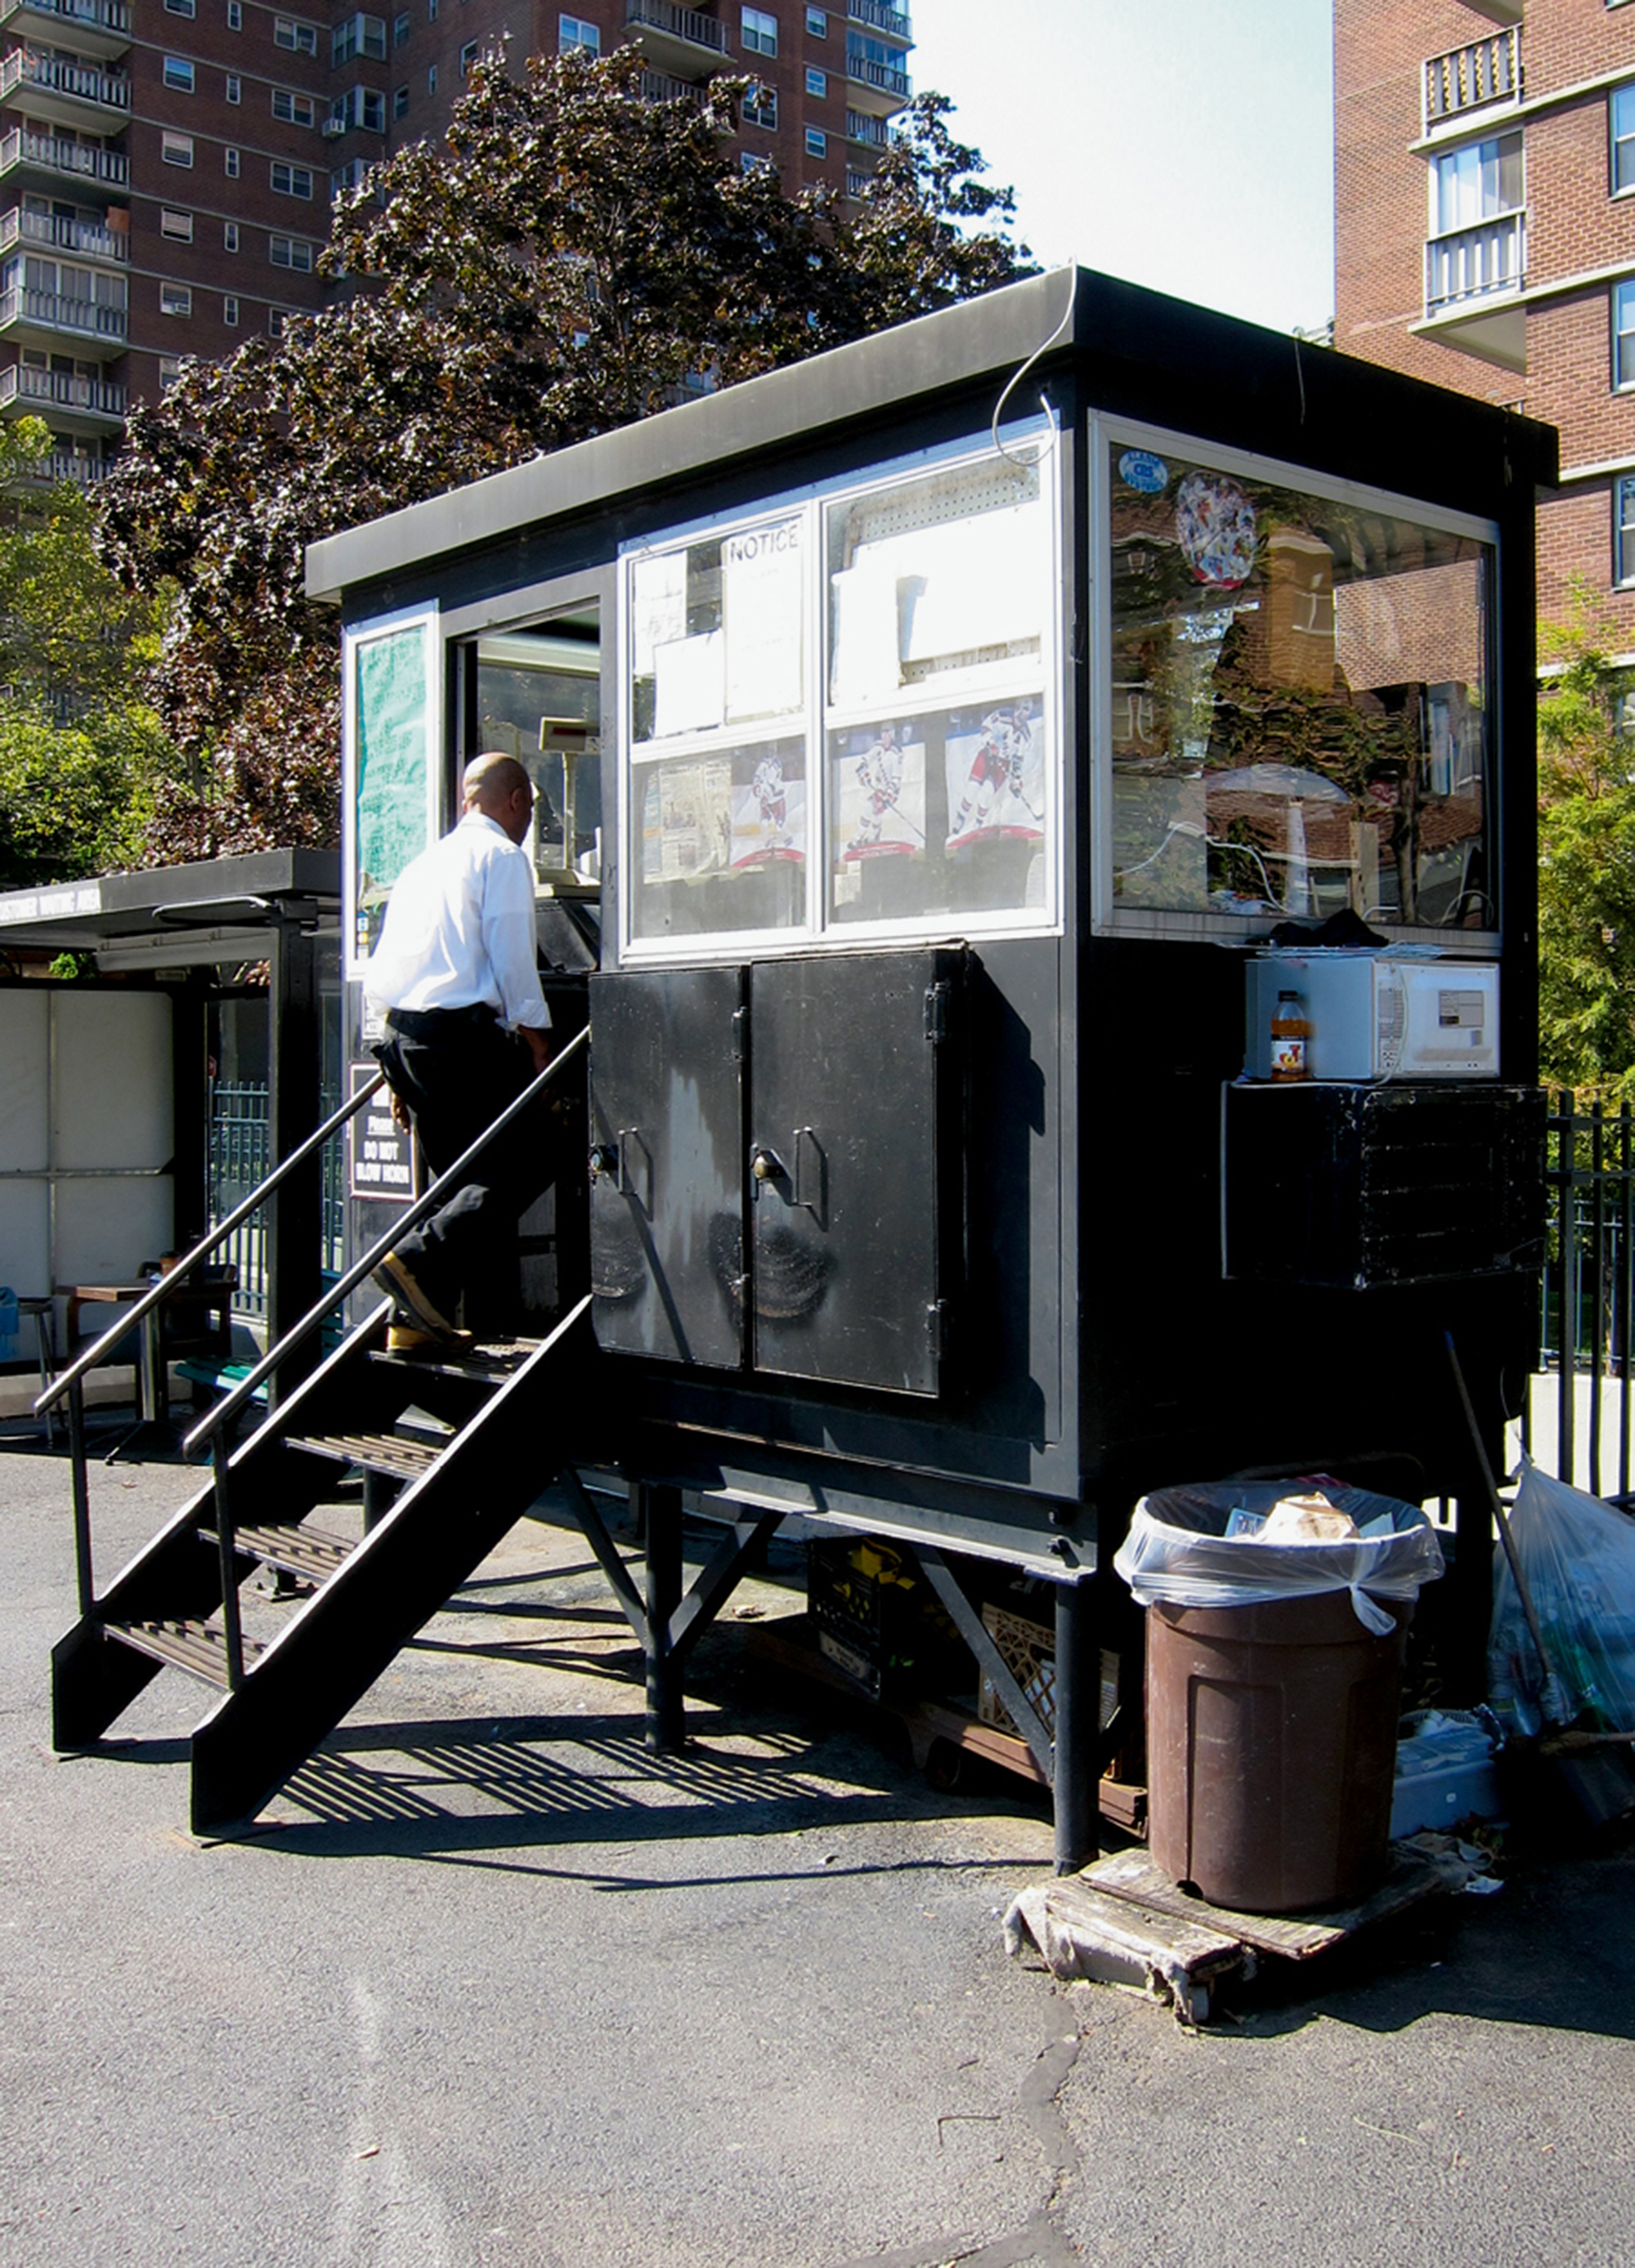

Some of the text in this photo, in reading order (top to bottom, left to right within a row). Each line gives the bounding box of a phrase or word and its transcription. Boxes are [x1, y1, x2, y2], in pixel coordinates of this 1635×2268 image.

[730, 524, 798, 563] NOTICE
[77, 888, 101, 913] AREA
[364, 1141, 399, 1161] DO NOT
[356, 1162, 410, 1184] BLOW HORN
